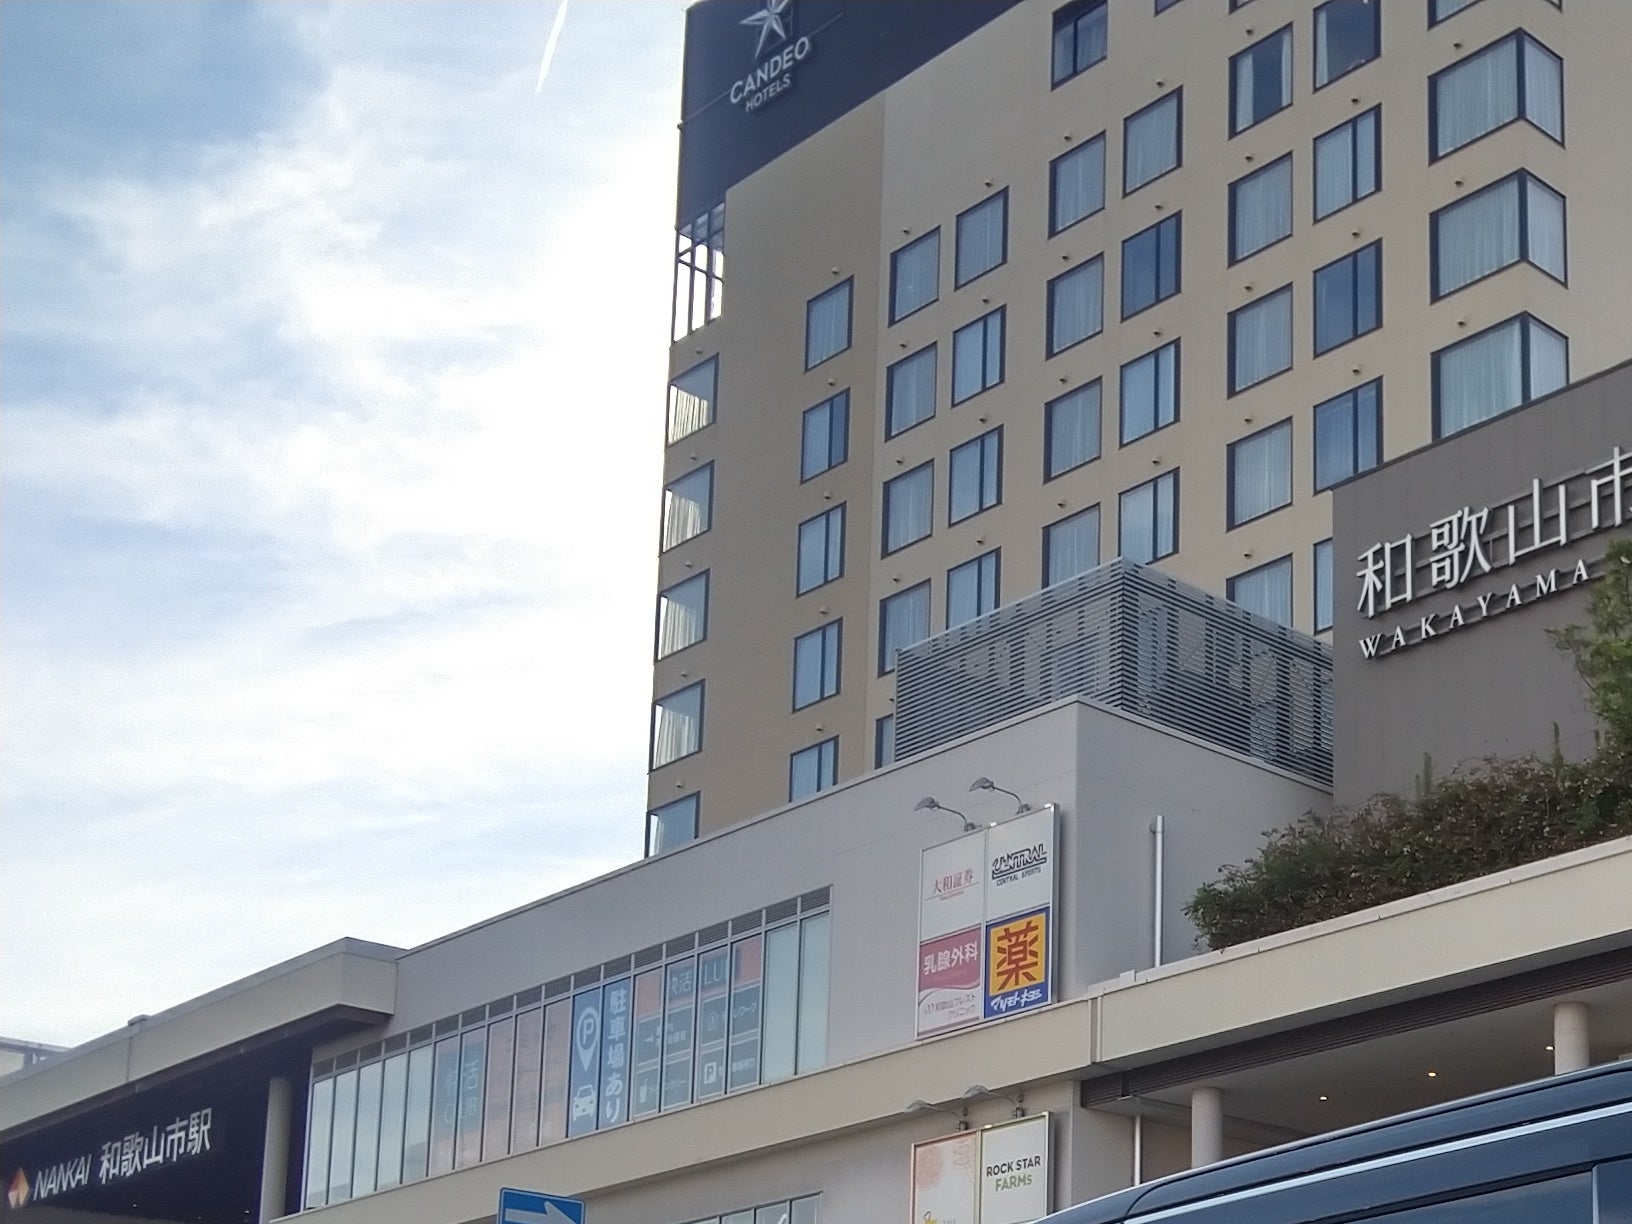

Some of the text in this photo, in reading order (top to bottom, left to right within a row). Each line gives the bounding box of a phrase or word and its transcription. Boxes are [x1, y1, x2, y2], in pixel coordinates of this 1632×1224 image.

[729, 36, 809, 104] CANDEO
[746, 73, 791, 113] HOTELS
[1359, 559, 1589, 659] WAKAYAMA
[992, 843, 1047, 880] CENTRAL
[996, 867, 1042, 887] CENTRAL SPORTS
[923, 941, 978, 975] 乳腺外科
[997, 920, 1039, 991] 薬
[606, 989, 627, 1123] 駐車場あり
[34, 1107, 212, 1200] NANKAI 和歌山市駅
[986, 1155, 1041, 1177] ROCK STAR
[995, 1174, 1033, 1192] FARMS
